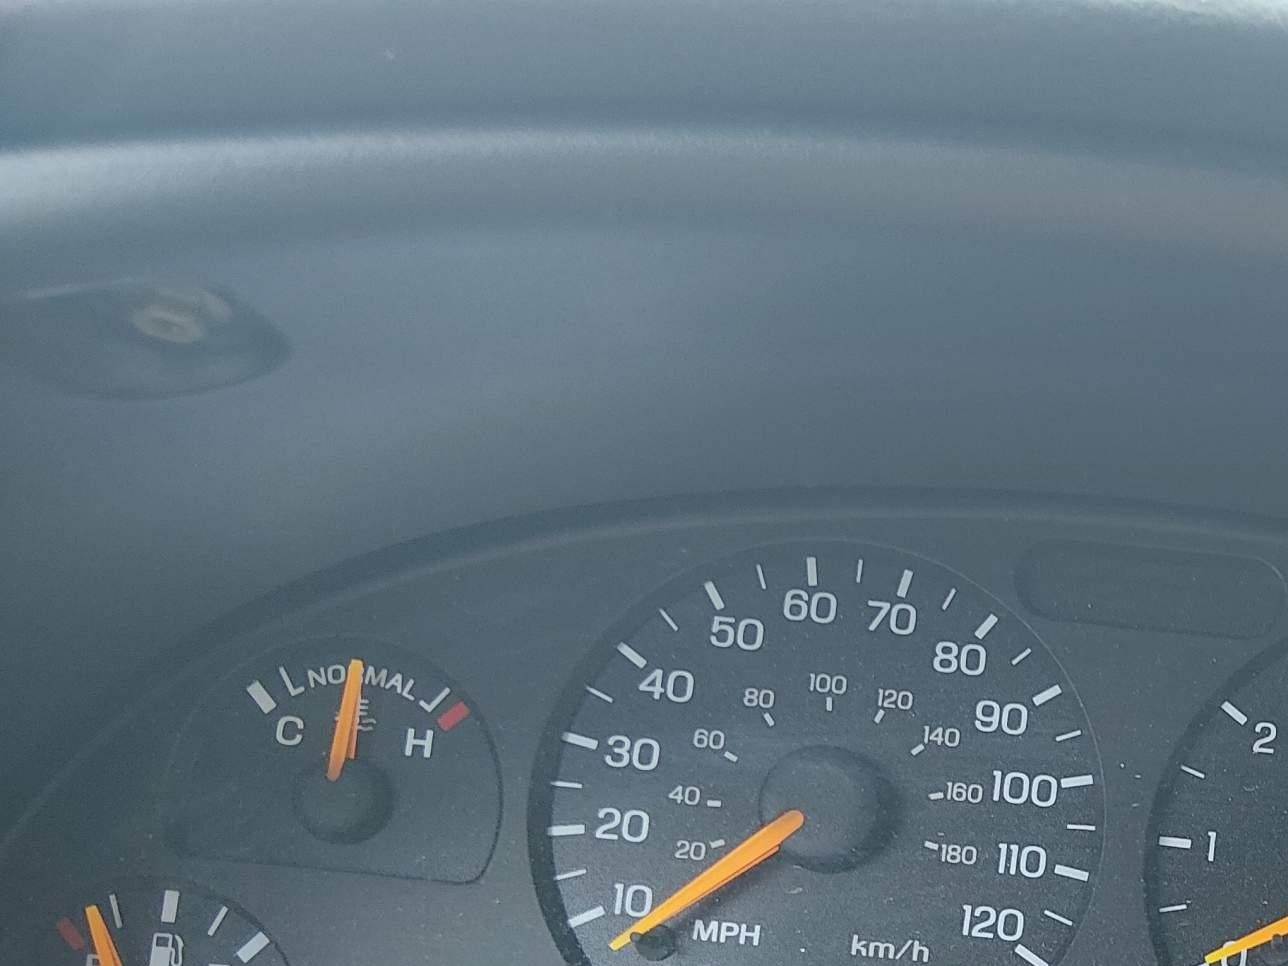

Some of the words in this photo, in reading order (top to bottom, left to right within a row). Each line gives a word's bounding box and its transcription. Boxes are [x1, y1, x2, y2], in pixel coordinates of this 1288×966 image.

[783, 589, 837, 624] 60
[867, 600, 917, 635] 70
[710, 616, 764, 650] 50
[933, 641, 987, 676] 80
[307, 664, 415, 701] NOMAL
[638, 669, 695, 703] 40
[743, 688, 775, 708] 80
[809, 673, 847, 695] 100
[877, 688, 913, 710] 120
[276, 716, 304, 745] C
[975, 700, 1028, 735] 90
[404, 728, 433, 758] H
[693, 729, 725, 750] 60
[923, 726, 960, 747] 140
[1252, 722, 1277, 754] 2
[604, 735, 660, 771] 30
[668, 785, 701, 805] 40
[946, 782, 983, 803] 160
[992, 770, 1058, 807] 100
[595, 808, 650, 843] 20
[674, 840, 706, 860] 20
[941, 844, 977, 865] 180
[998, 843, 1047, 878] 110
[1207, 831, 1217, 862] 1
[614, 883, 652, 917] 10
[692, 920, 761, 946] MPH
[962, 904, 1024, 941] 120
[850, 935, 930, 962] km/h
